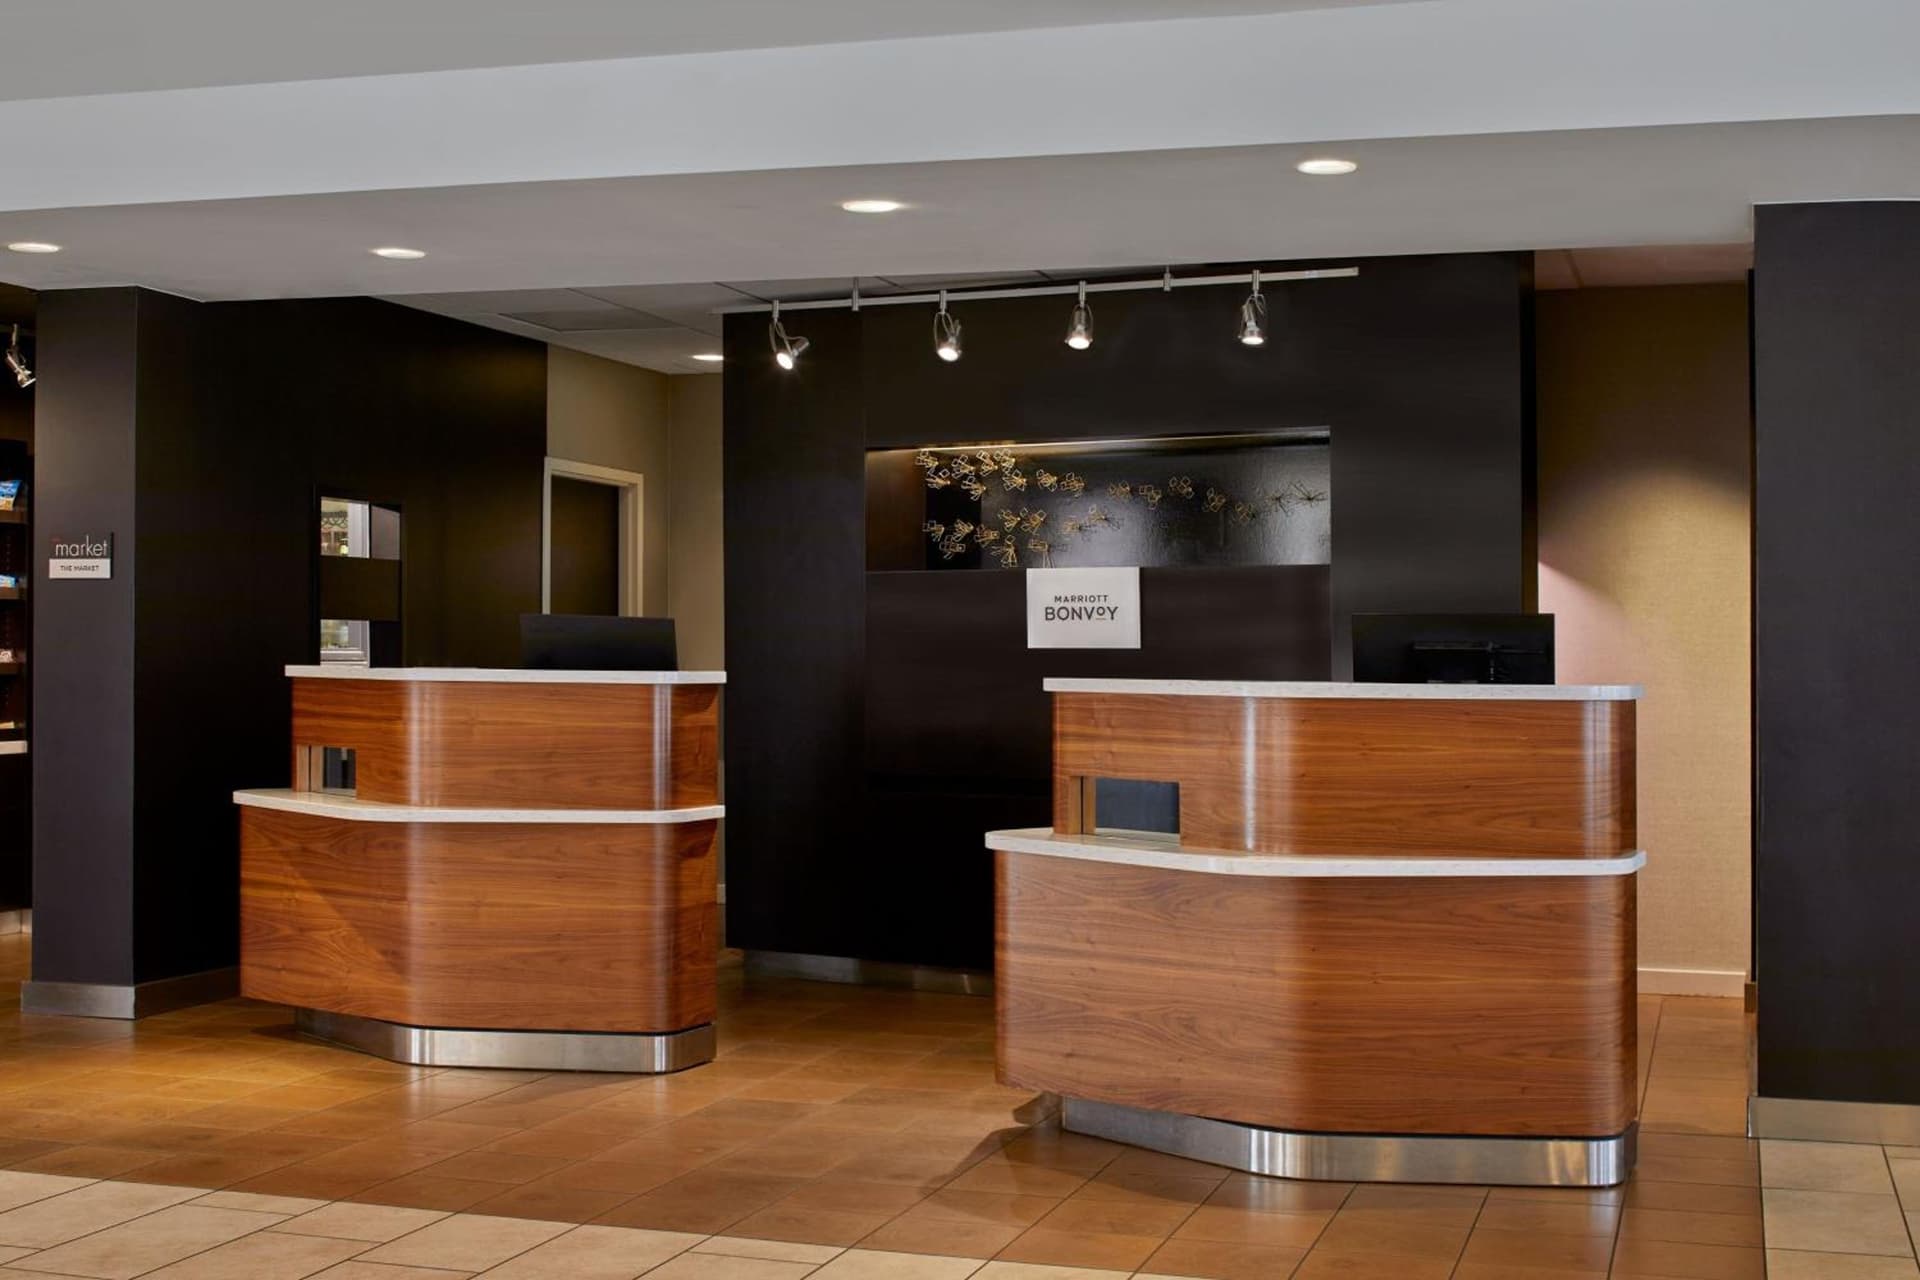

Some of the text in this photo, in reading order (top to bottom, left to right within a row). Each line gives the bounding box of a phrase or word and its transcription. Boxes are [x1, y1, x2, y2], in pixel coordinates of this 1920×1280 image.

[55, 535, 107, 556] market
[1054, 595, 1108, 603] MARRIOTT
[1044, 606, 1119, 621] BONVOY
